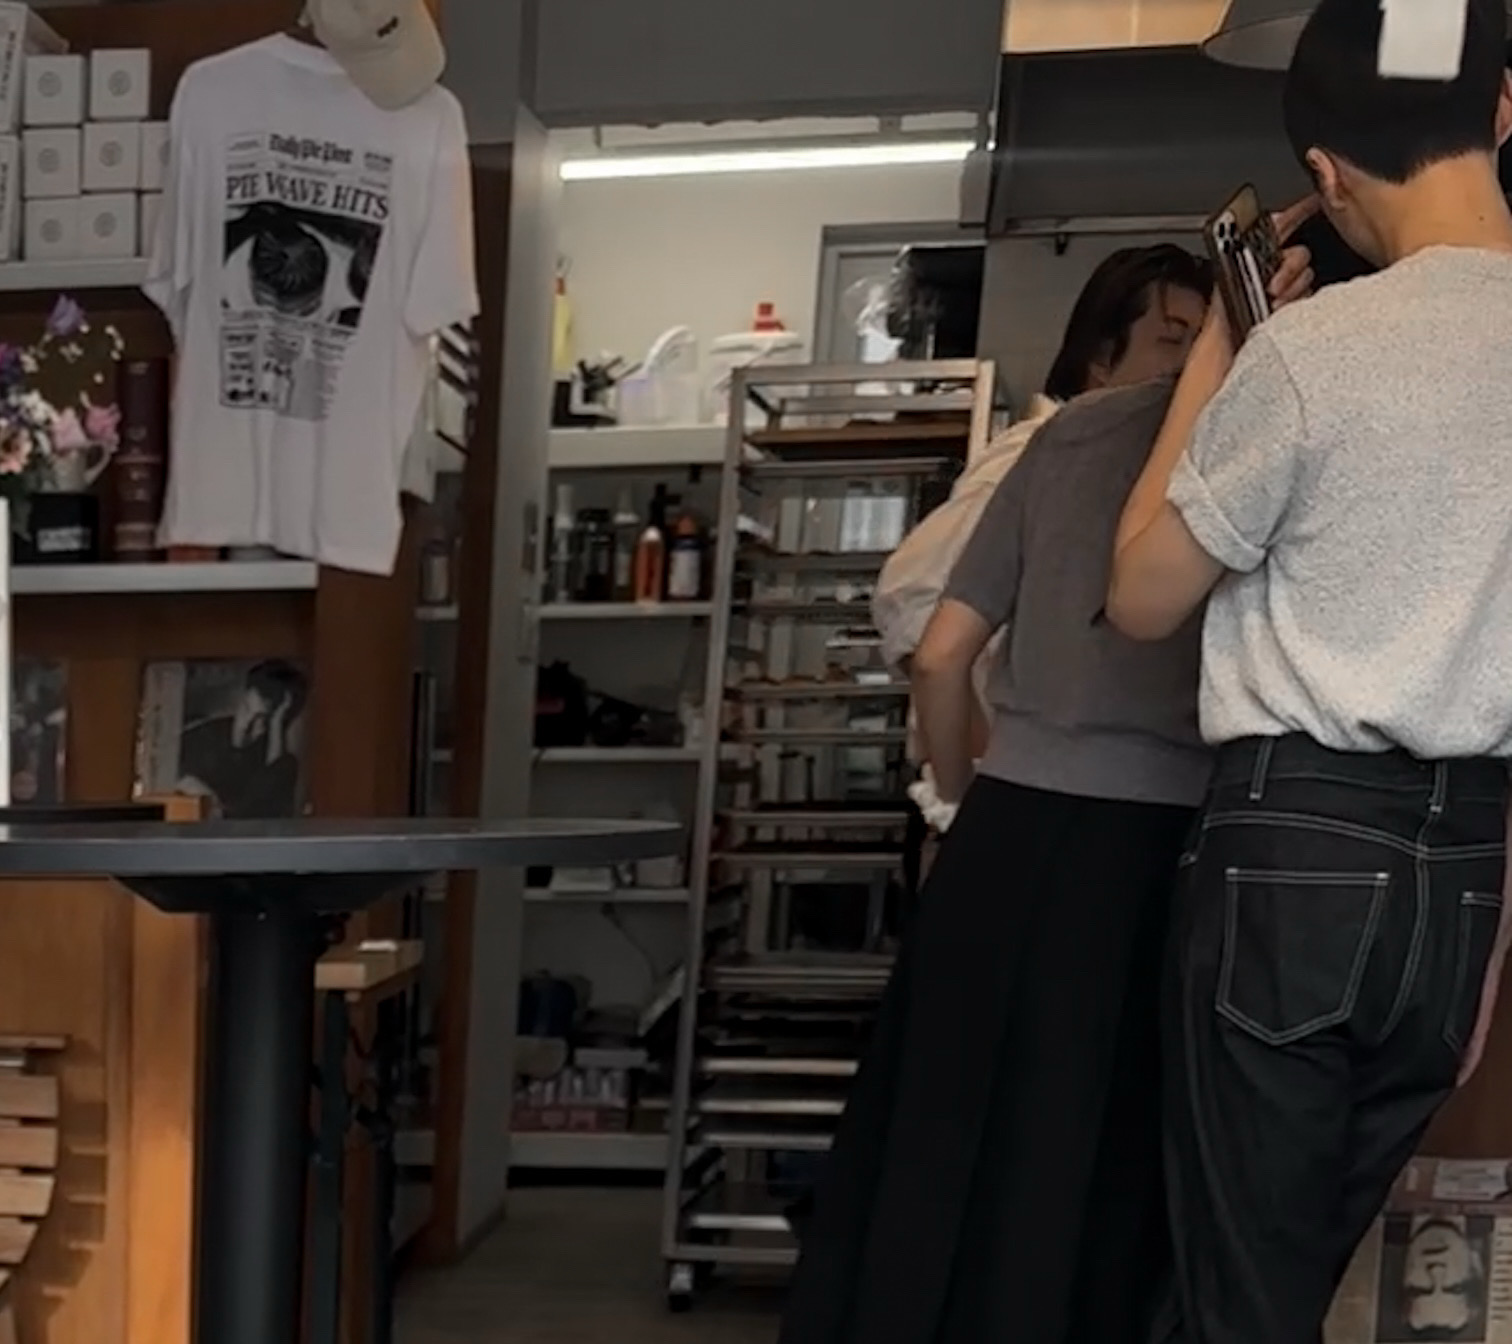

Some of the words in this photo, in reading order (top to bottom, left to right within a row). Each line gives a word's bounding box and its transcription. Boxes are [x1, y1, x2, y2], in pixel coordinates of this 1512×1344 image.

[226, 173, 259, 200] PIE
[265, 172, 328, 207] WAVE
[331, 184, 389, 220] HITS
